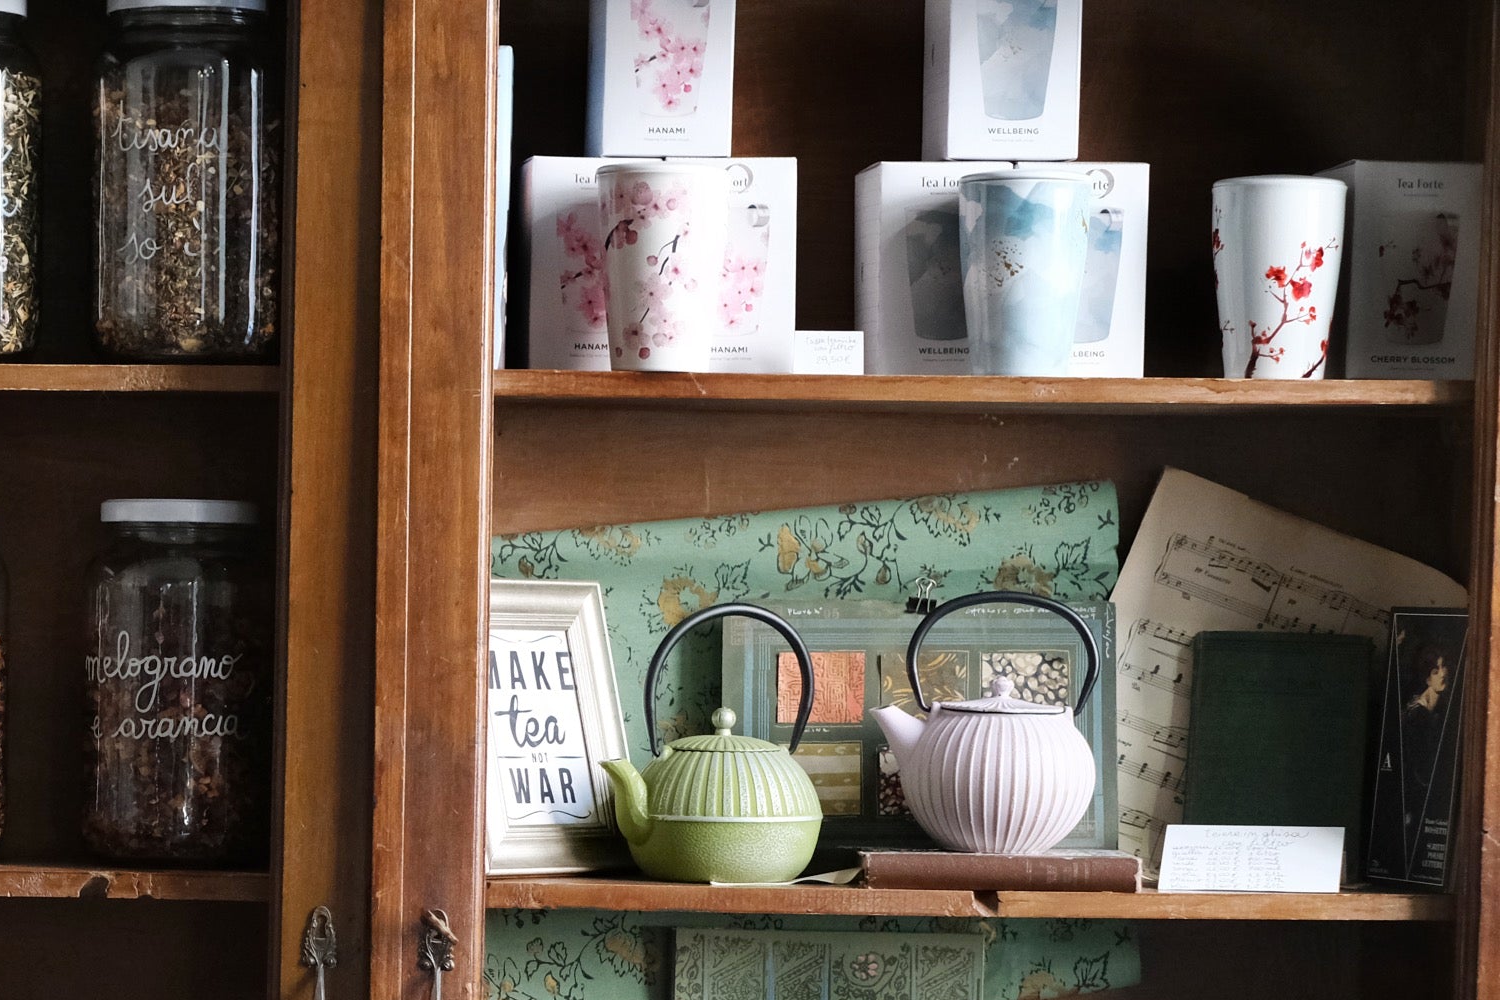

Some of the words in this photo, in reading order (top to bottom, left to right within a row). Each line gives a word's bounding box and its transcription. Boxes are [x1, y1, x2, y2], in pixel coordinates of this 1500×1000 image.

[648, 126, 687, 135] HANAMI
[987, 126, 1040, 136] WELLBEING
[942, 176, 961, 189] For
[573, 342, 609, 351] HANAM
[710, 345, 749, 354] HANAMI
[917, 346, 971, 356] WELLBEING
[1072, 349, 1106, 359] LBEING
[1370, 354, 1408, 364] CHERRY
[1409, 355, 1456, 365] BLOSSOM
[85, 630, 243, 714] melograno
[488, 649, 574, 691] MAKE
[114, 706, 248, 743] arancia
[493, 694, 567, 749] tea
[531, 752, 550, 764] NOT
[509, 767, 578, 805] WAR
